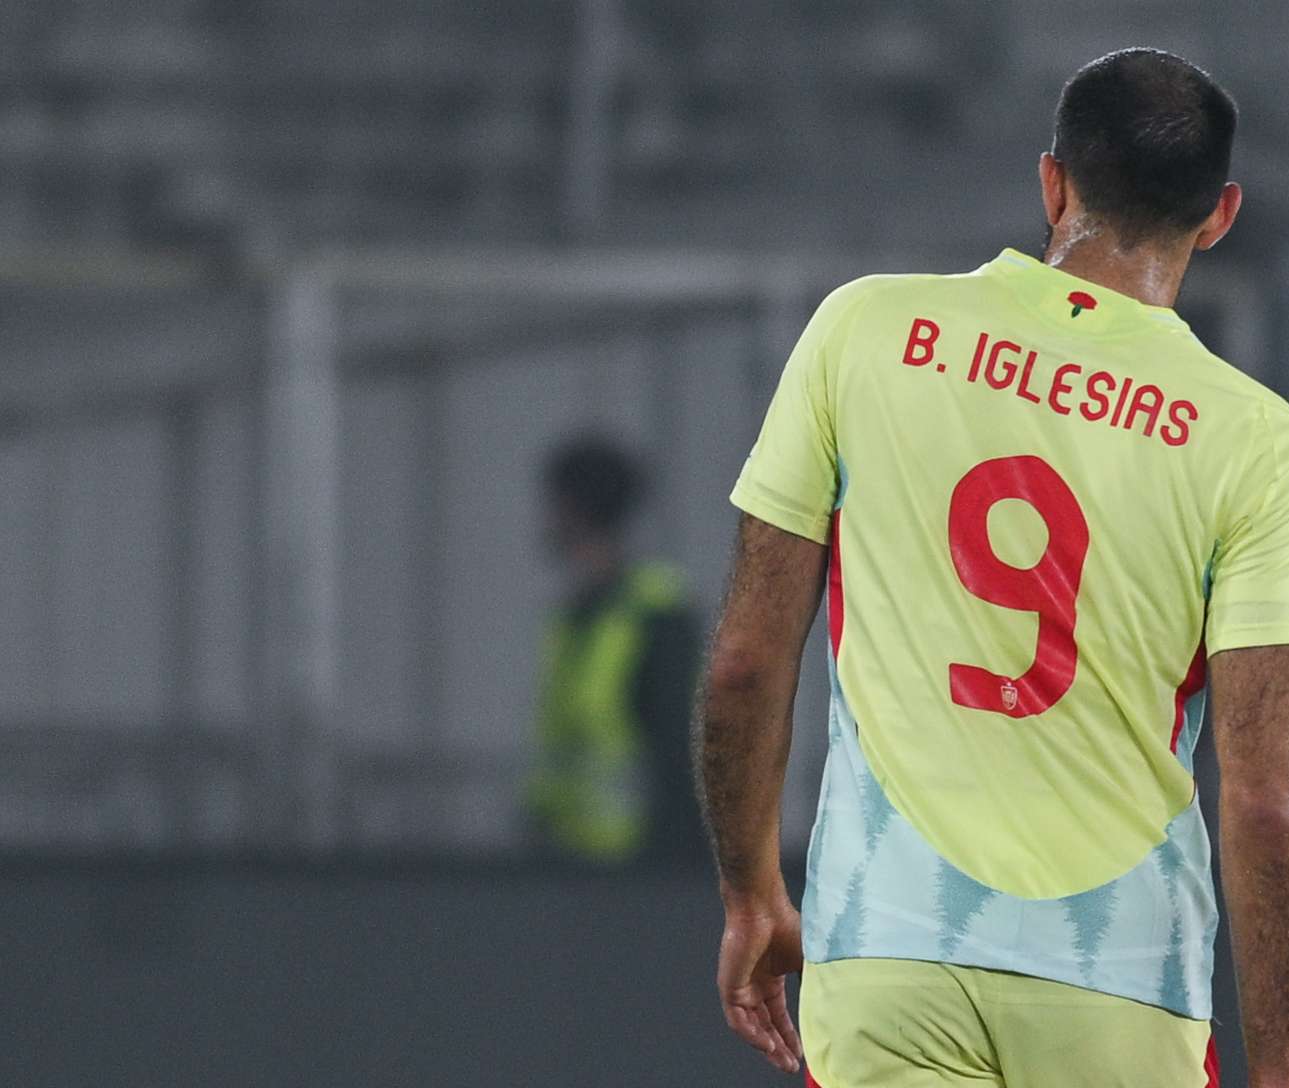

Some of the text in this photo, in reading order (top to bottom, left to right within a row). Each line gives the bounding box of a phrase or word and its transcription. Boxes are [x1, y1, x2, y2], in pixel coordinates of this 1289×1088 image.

[902, 317, 1199, 447] B. IGLESIAS
[948, 455, 1089, 719] 9
